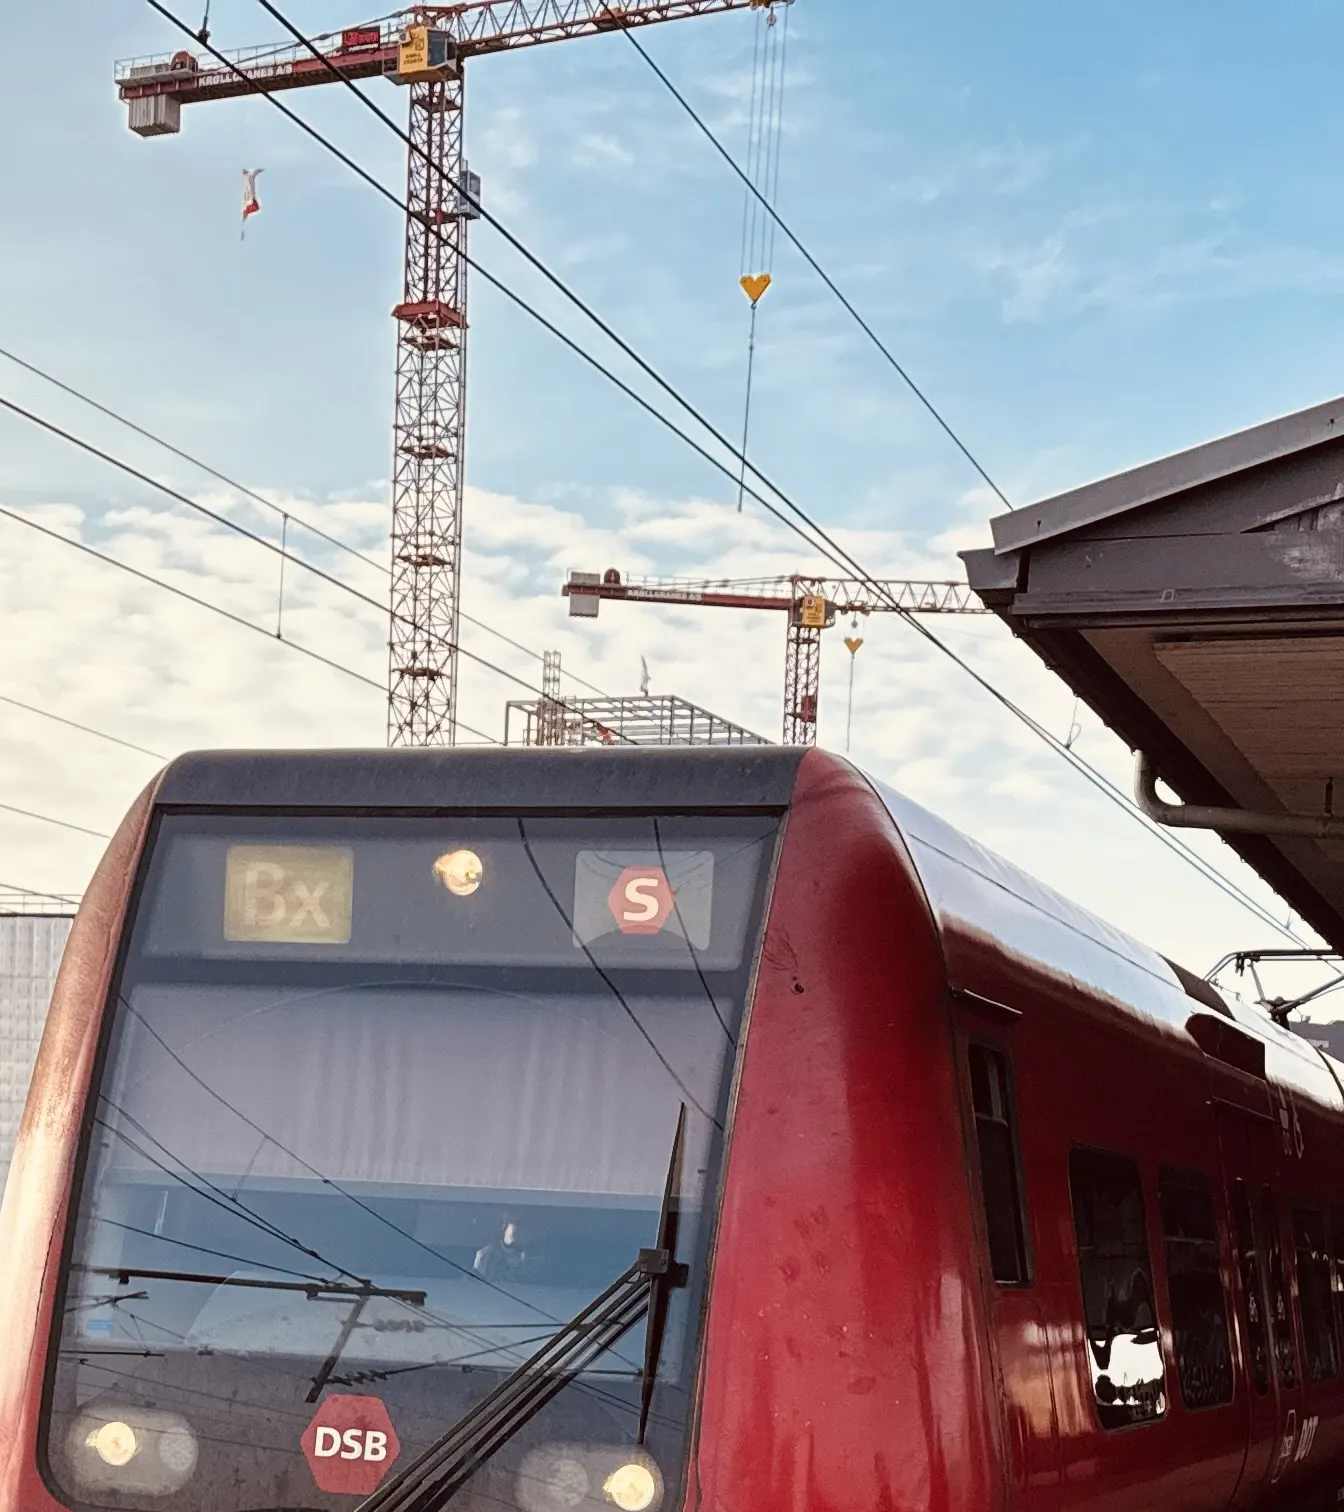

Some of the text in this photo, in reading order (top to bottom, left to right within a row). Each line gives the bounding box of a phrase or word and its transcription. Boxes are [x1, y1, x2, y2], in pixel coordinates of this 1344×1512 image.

[244, 861, 331, 928] Bx
[622, 877, 659, 922] S
[314, 1426, 387, 1462] DSB
